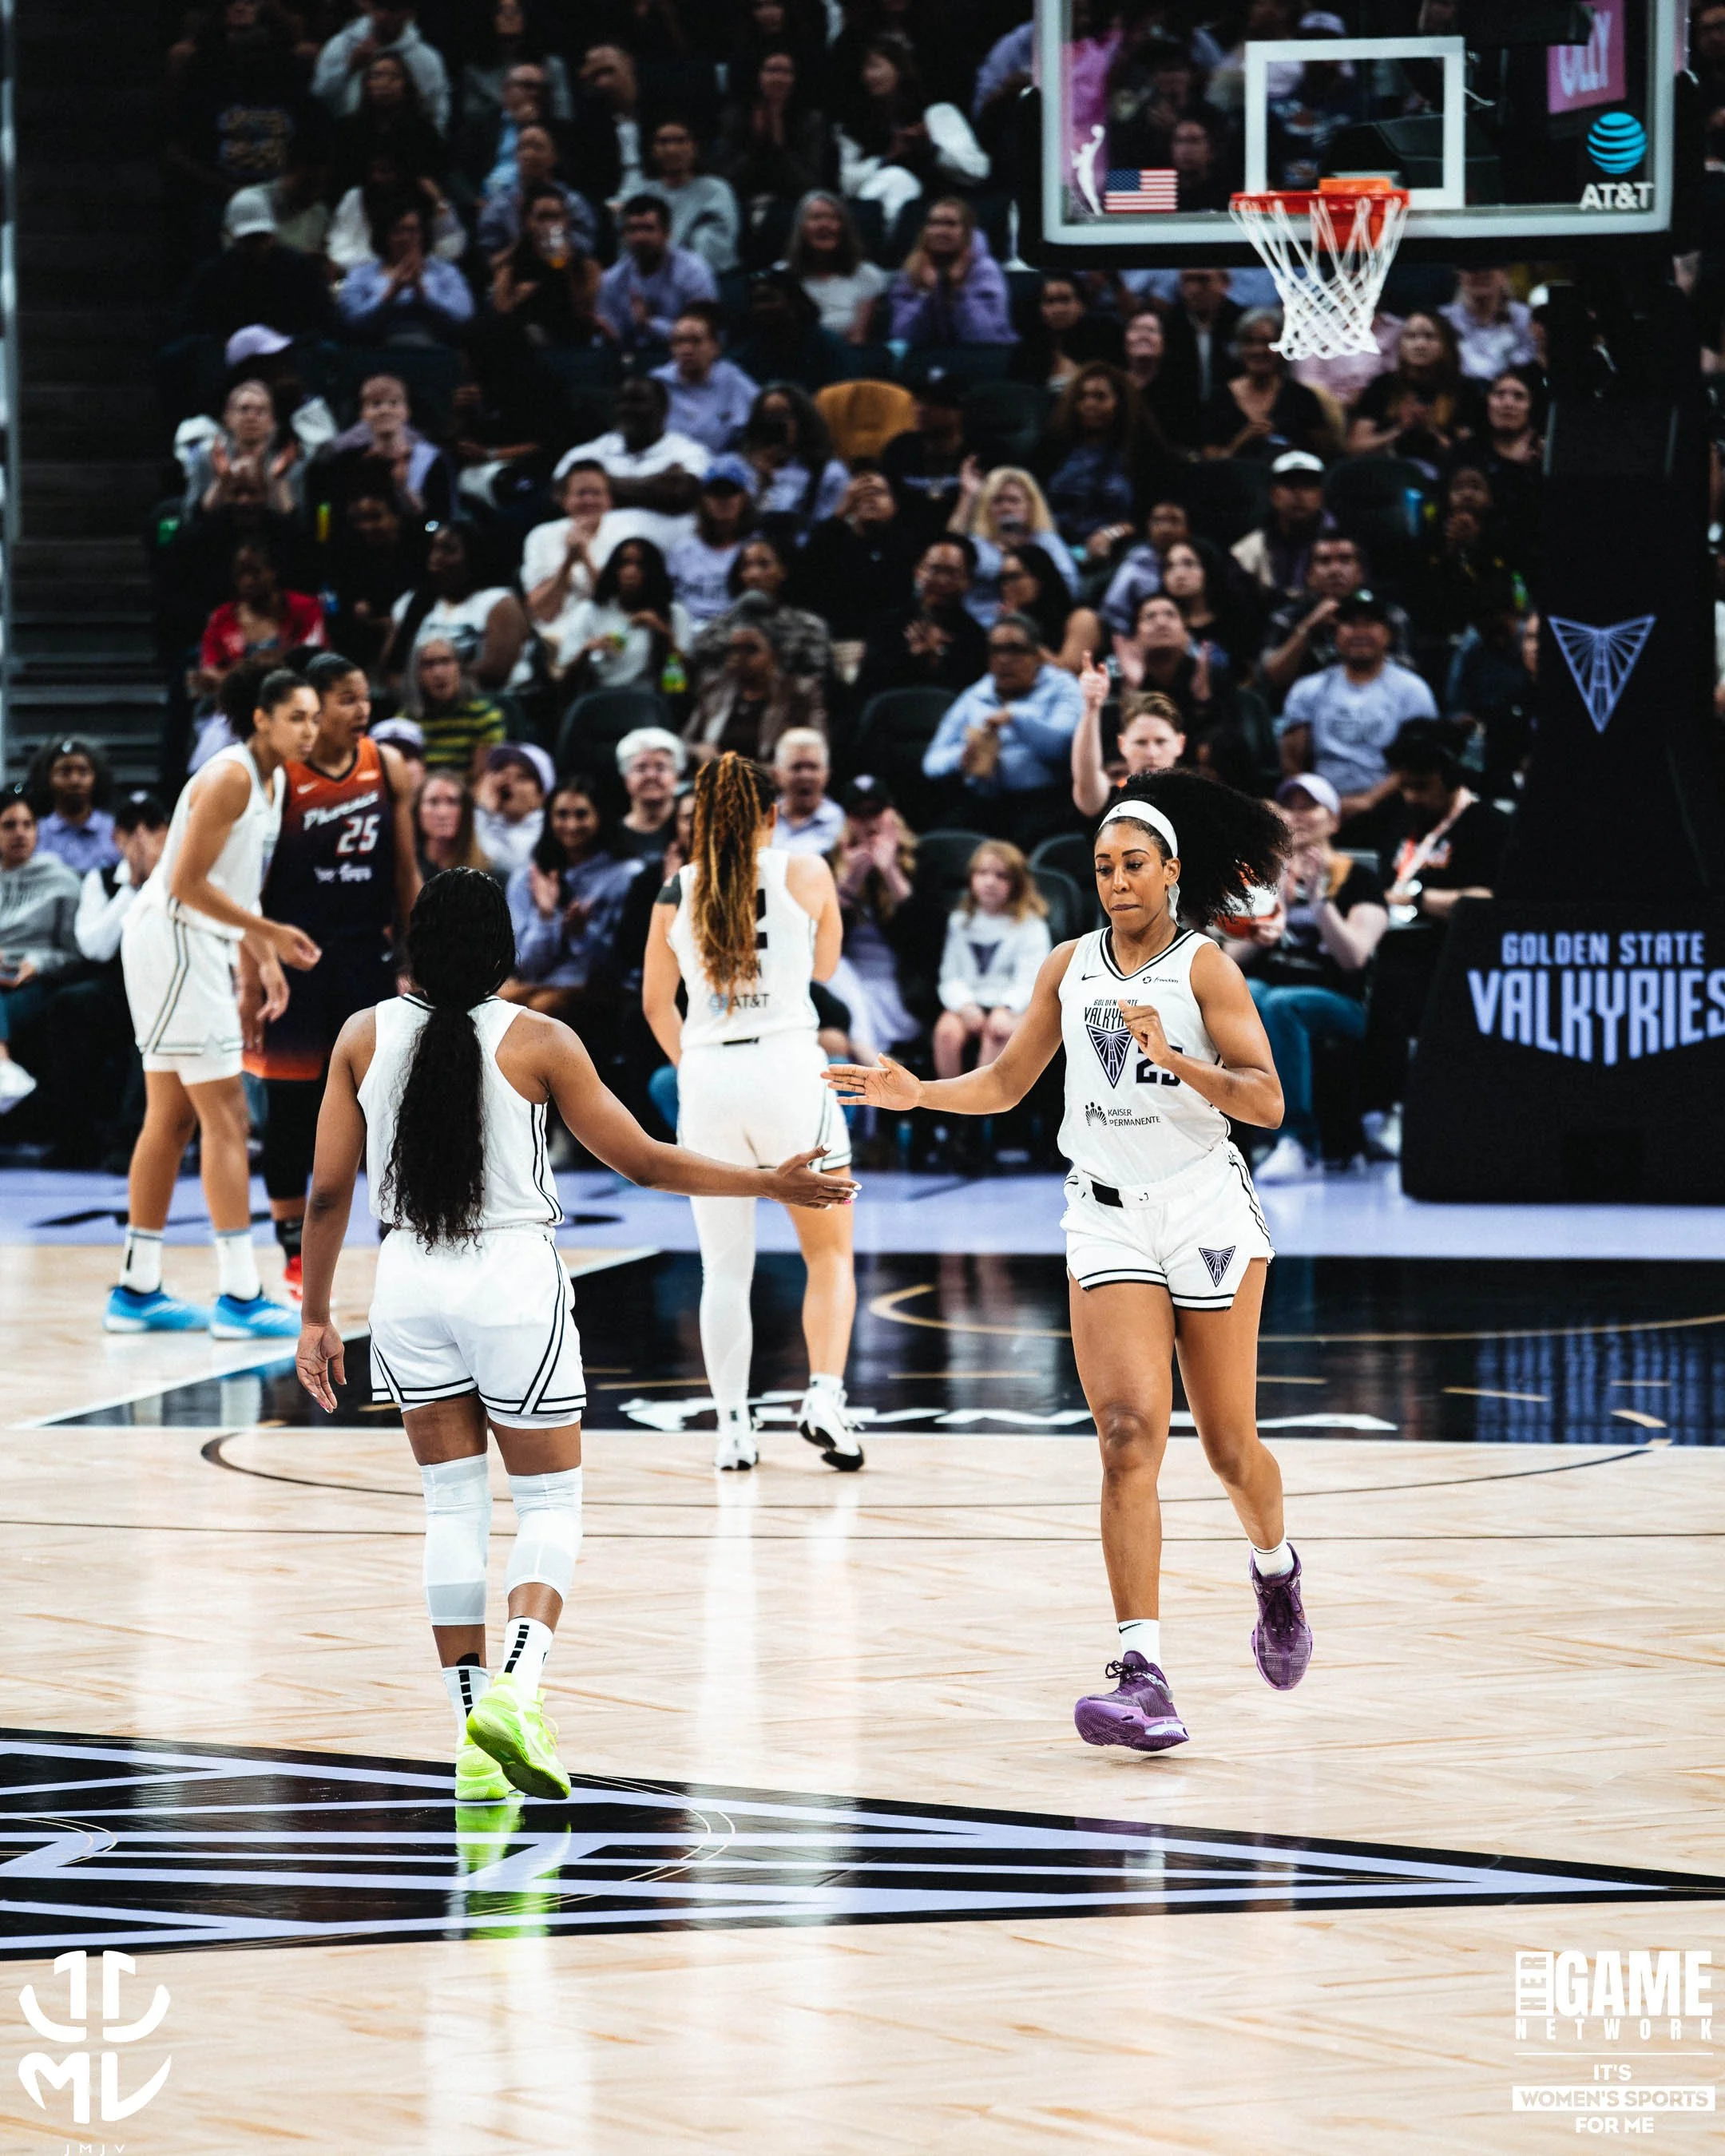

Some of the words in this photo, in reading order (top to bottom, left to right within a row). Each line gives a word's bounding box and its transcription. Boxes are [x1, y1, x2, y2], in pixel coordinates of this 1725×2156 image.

[1579, 181, 1655, 211] AT&T
[335, 814, 380, 856] 25
[1501, 932, 1609, 965] GOLDEN
[1619, 932, 1705, 965] STATE
[1466, 969, 1725, 1066] VALKYRIES
[1109, 1116, 1161, 1127] PERMANENTE
